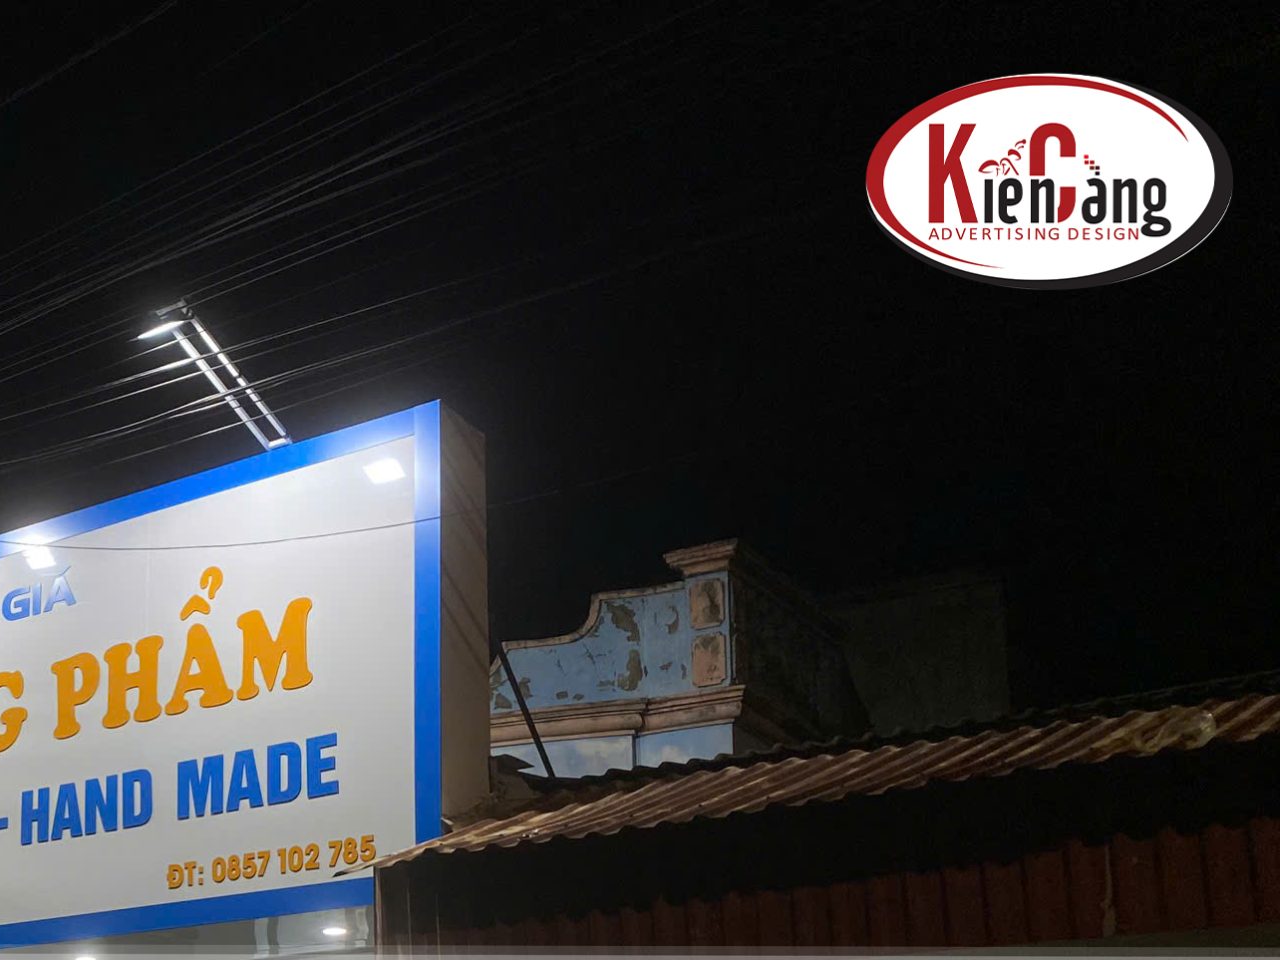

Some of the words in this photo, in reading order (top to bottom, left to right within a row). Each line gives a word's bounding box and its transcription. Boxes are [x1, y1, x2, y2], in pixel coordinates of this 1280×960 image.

[1, 565, 77, 622] GIÁ
[50, 566, 314, 740] PHẨM
[20, 768, 153, 846] HAND
[176, 732, 340, 820] MADE
[166, 861, 204, 889] ĐT:
[211, 850, 271, 883] 0857
[277, 843, 320, 875] 102
[327, 834, 376, 867] 785
